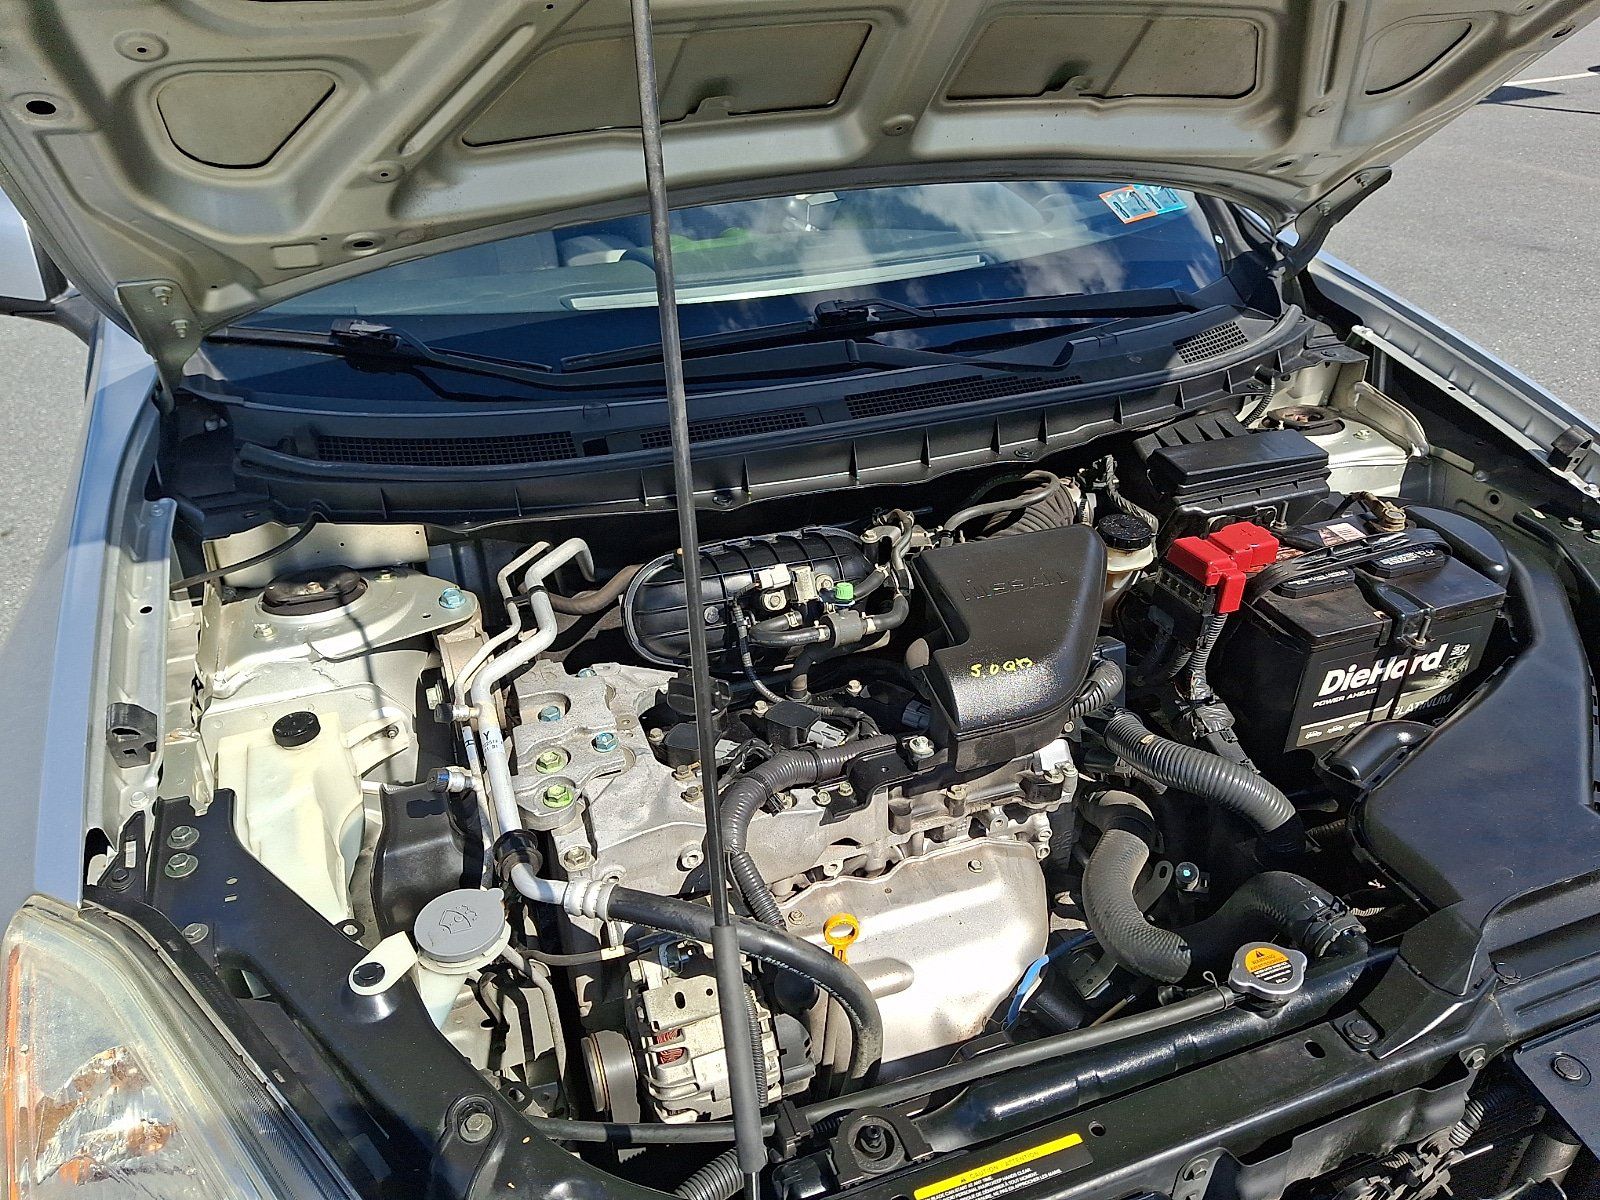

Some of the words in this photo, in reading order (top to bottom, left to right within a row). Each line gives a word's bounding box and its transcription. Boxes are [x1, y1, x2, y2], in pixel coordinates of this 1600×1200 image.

[960, 567, 1069, 601] NISSAN
[1318, 643, 1449, 697] DieHard
[1312, 695, 1345, 708] POWER
[1347, 688, 1378, 700] AHEAD
[969, 1164, 999, 1179] CAUTION
[1005, 1151, 1039, 1167] ATTENTION
